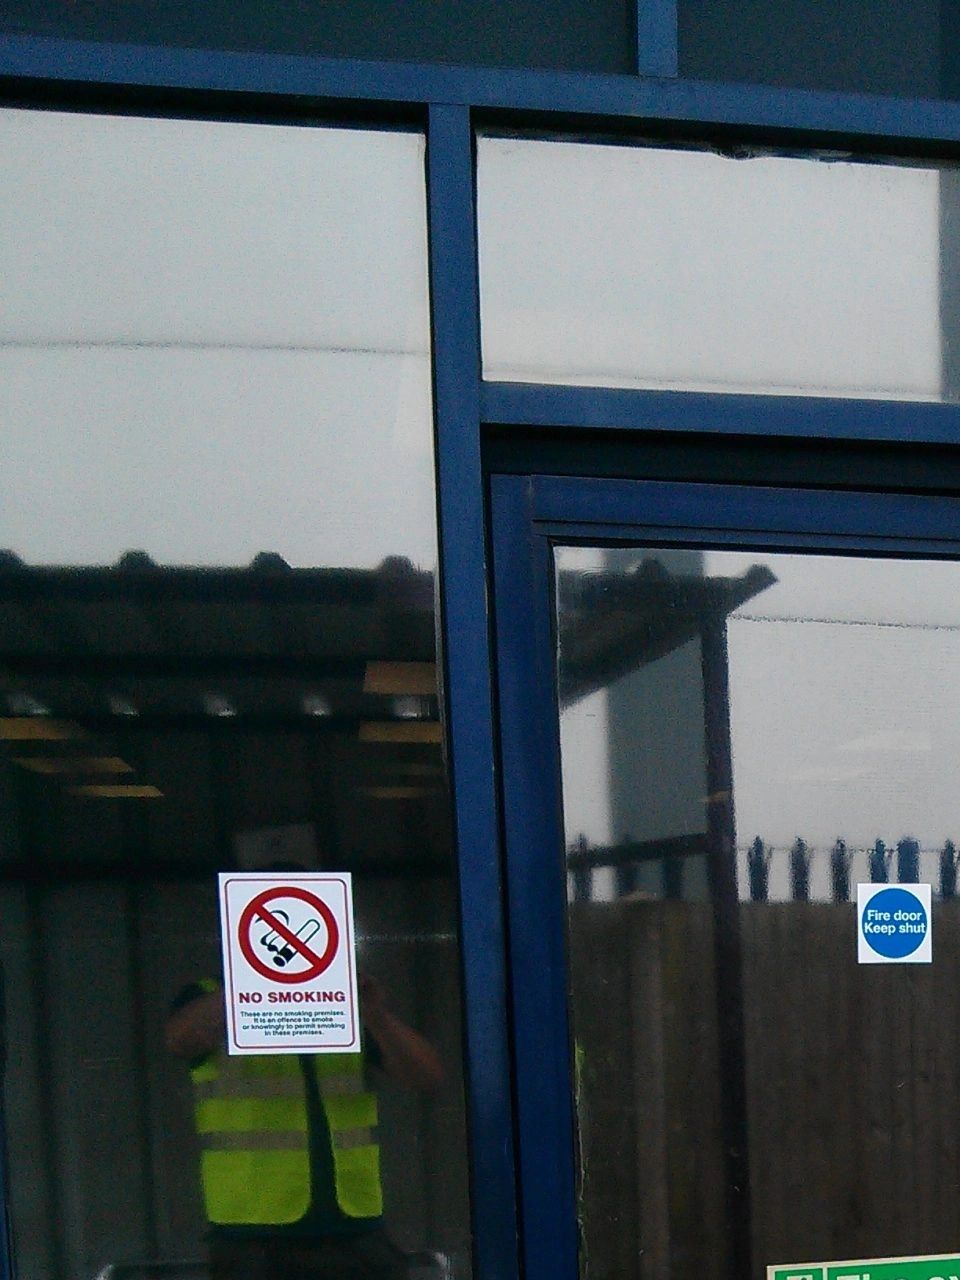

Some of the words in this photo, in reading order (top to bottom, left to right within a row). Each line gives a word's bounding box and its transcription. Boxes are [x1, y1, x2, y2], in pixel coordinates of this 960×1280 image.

[868, 910, 890, 920] Fire
[894, 910, 922, 920] door
[865, 922, 896, 935] Keep
[899, 923, 925, 933] shut
[239, 992, 262, 1003] NO
[268, 992, 345, 1003] SMOKING
